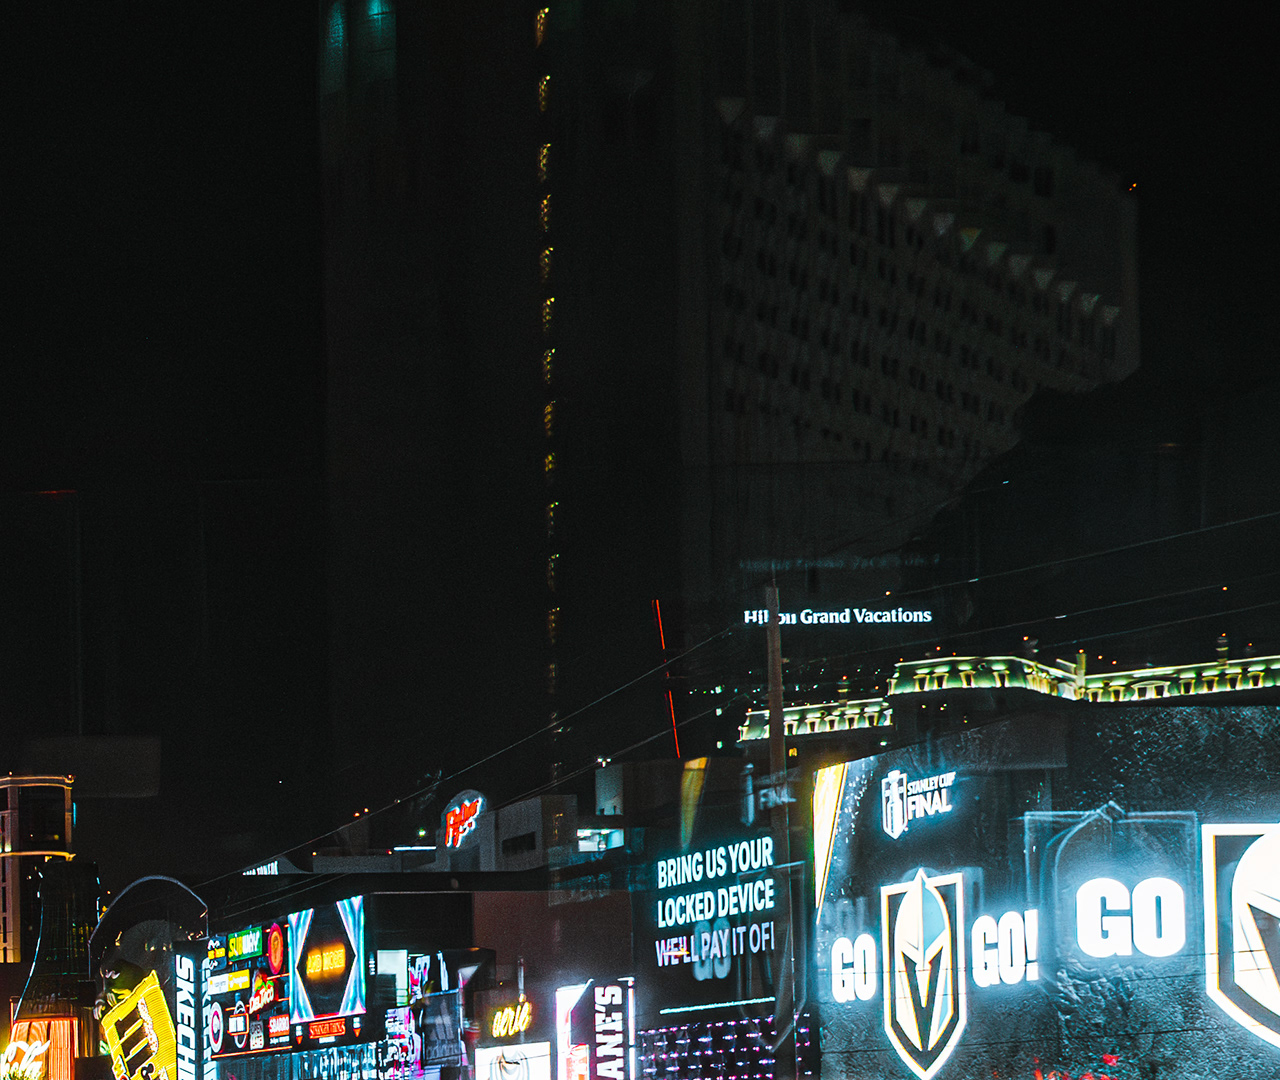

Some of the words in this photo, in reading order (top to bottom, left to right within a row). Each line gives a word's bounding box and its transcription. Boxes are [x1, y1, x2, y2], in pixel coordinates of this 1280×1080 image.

[744, 609, 797, 625] Hilon
[800, 608, 850, 624] Grand
[853, 607, 932, 624] Vacations
[907, 776, 938, 795] STANLEY
[939, 771, 956, 788] CUP
[907, 788, 952, 820] FINAL
[657, 852, 704, 889] BRING
[705, 846, 727, 879] US
[728, 836, 773, 874] YOUR
[657, 890, 715, 928] LOCKED
[717, 878, 775, 918] DEVICE
[1075, 877, 1186, 957] GO
[228, 930, 260, 958] SUBWAY
[655, 935, 699, 967] WE'LL
[701, 928, 730, 960] PAY
[732, 925, 746, 956] IT
[971, 908, 1038, 988] GO!
[831, 933, 877, 1005] GO
